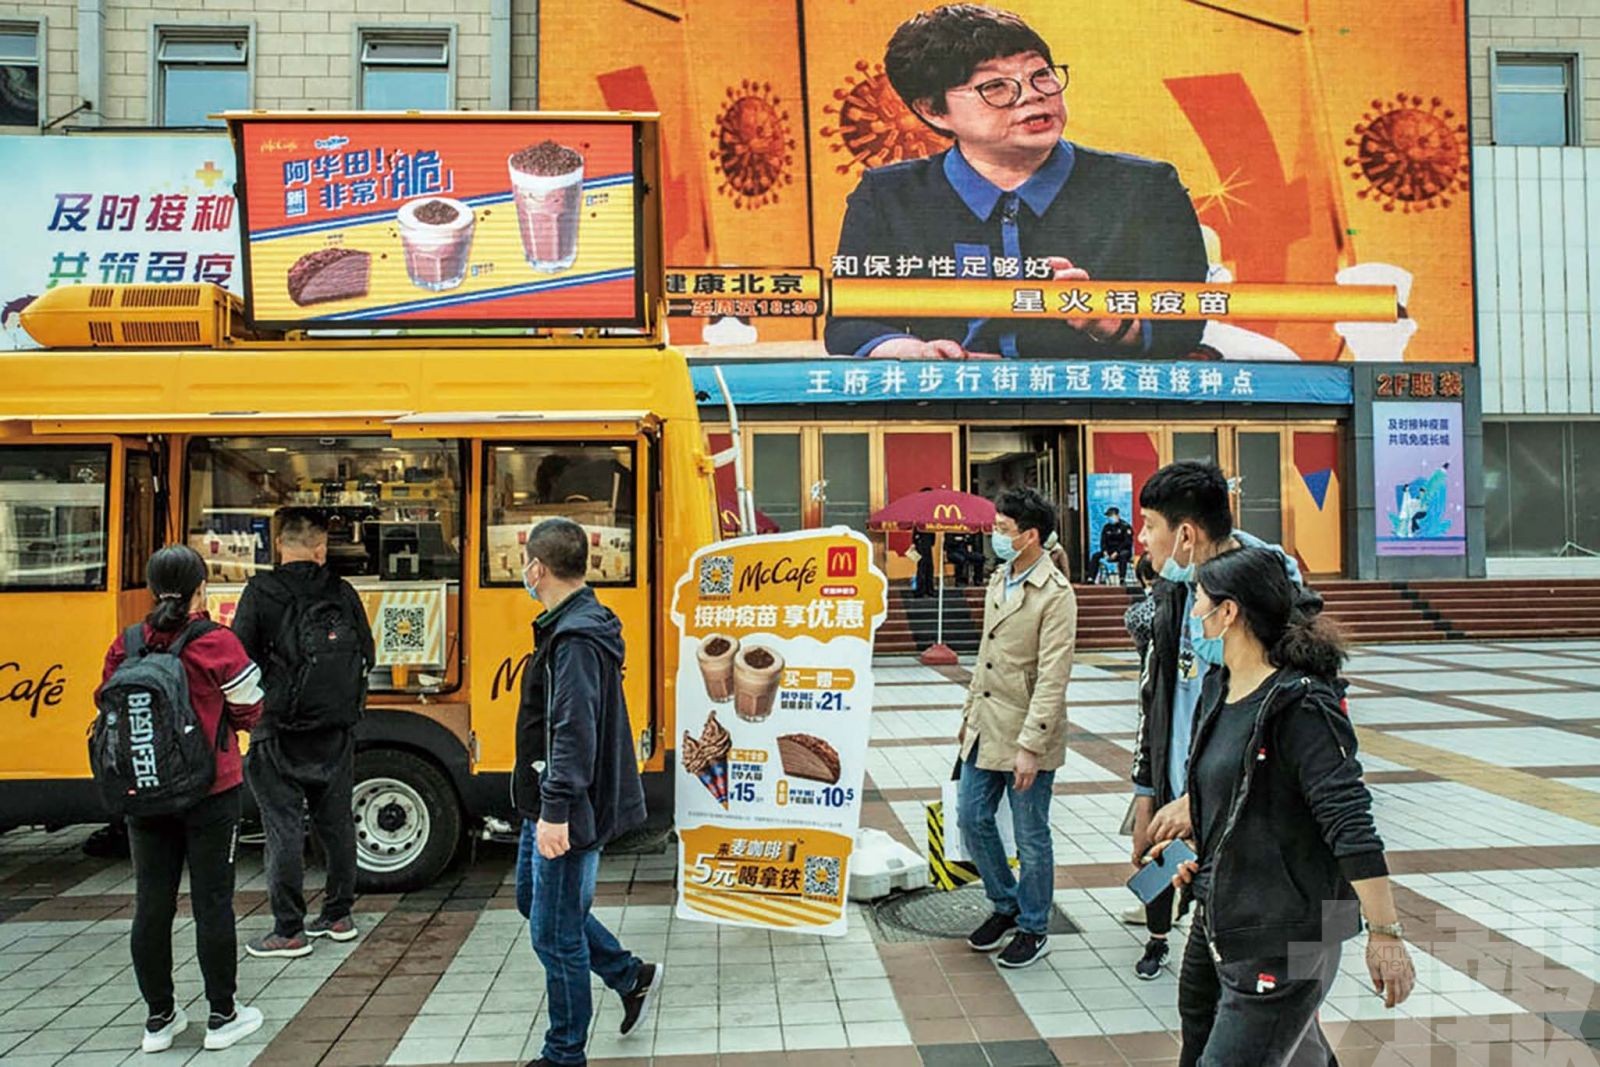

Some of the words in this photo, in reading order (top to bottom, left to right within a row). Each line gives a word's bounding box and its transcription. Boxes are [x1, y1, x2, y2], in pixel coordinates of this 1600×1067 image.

[284, 148, 385, 187] 阿华田!
[48, 193, 236, 232] 及时接种
[831, 255, 1052, 278] 和保护性足够好
[667, 299, 818, 316] 一至周五18:30
[1012, 289, 1230, 315] 星火话疫苗
[806, 363, 1254, 396] 王府井步行街新冠疫苗接种点
[1388, 418, 1449, 430] 及时接种疫苗
[1388, 433, 1450, 446] 共筑免疫长城
[738, 556, 818, 593] McCafé
[694, 605, 778, 628] 接种疫苗
[783, 599, 866, 629] 享优惠
[716, 838, 783, 860] 来麦咖啡
[690, 852, 802, 890] 5元喝拿铁
